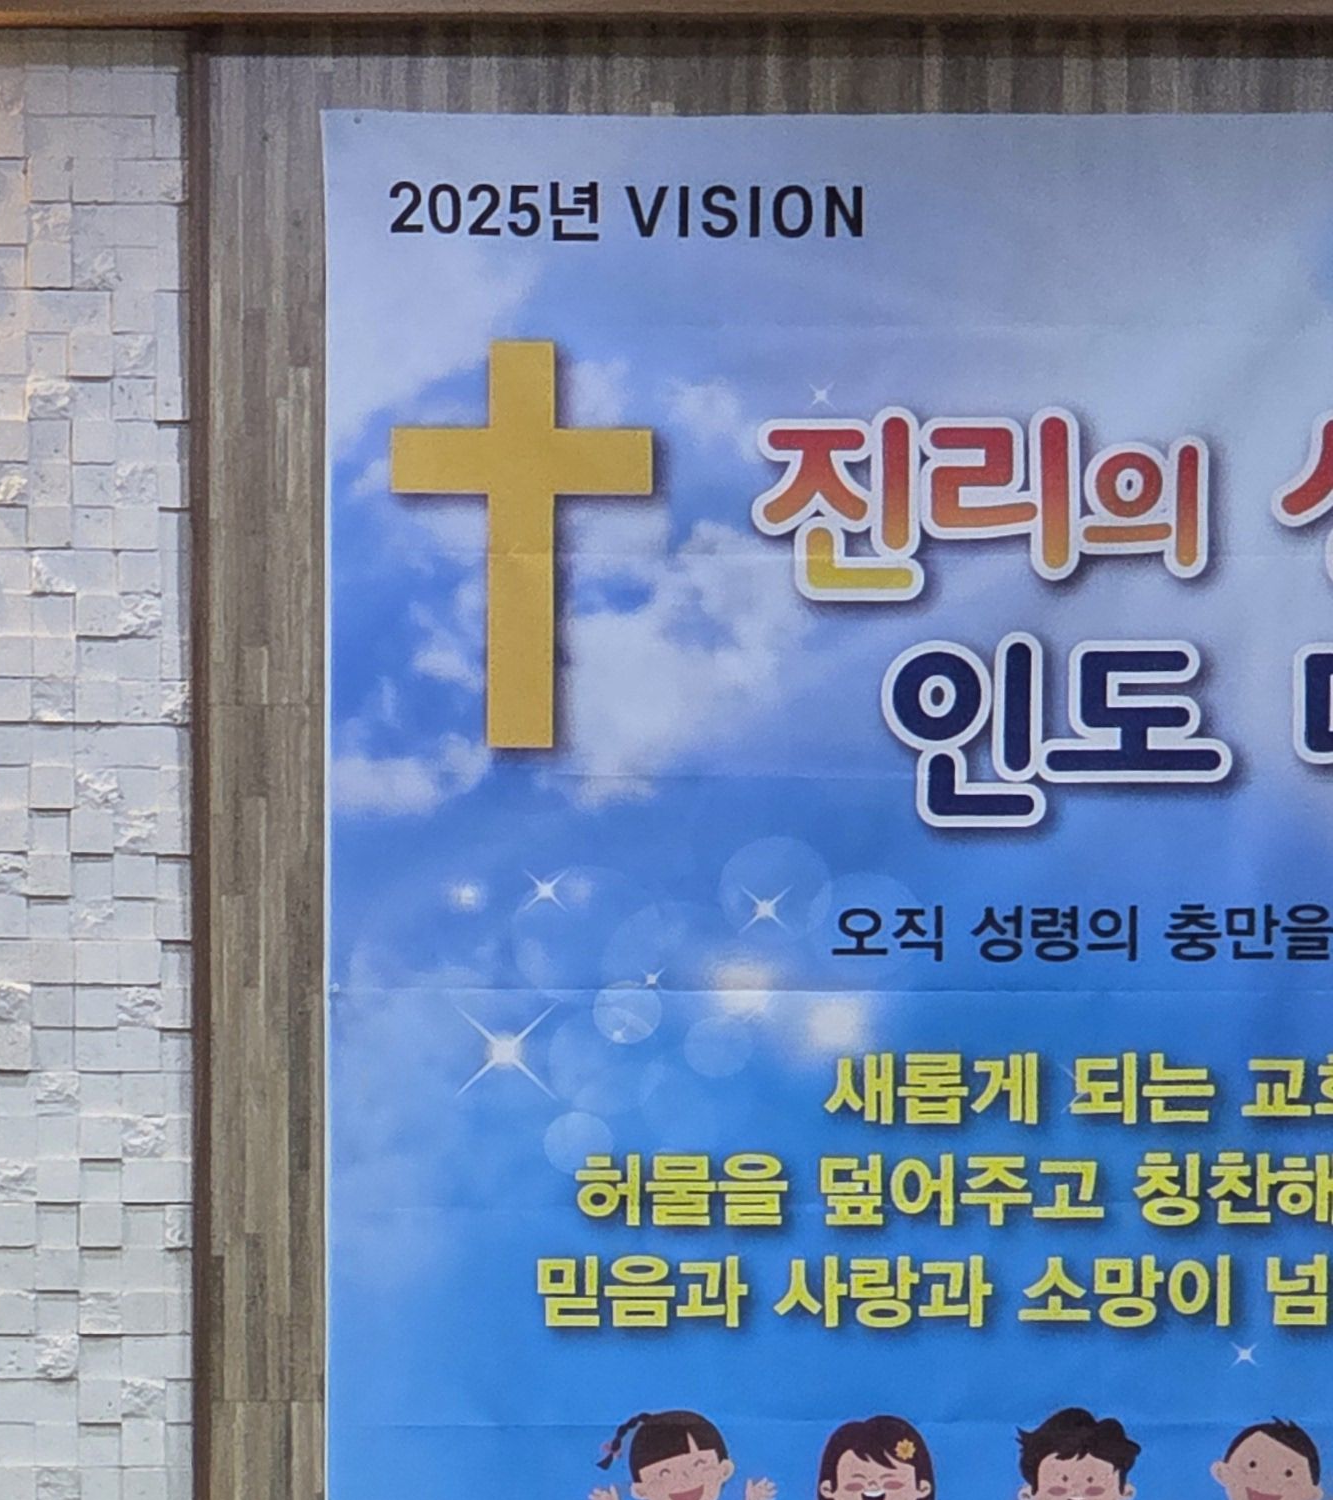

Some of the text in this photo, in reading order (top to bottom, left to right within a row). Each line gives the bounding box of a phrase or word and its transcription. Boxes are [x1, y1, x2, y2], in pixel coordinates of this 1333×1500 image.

[389, 181, 865, 242] 2025년 VISION
[755, 406, 1208, 601] 진리의
[883, 632, 1232, 826] 인도
[831, 903, 1333, 963] 오직 성령의 충만을
[824, 1052, 1333, 1125] 새롭게 되는 교
[575, 1154, 788, 1226] 허물을
[819, 1154, 1104, 1227] 덮어주고
[537, 1256, 748, 1328] 믿음과
[776, 1256, 992, 1328] 사랑과
[1018, 1255, 1231, 1328] 소망이
